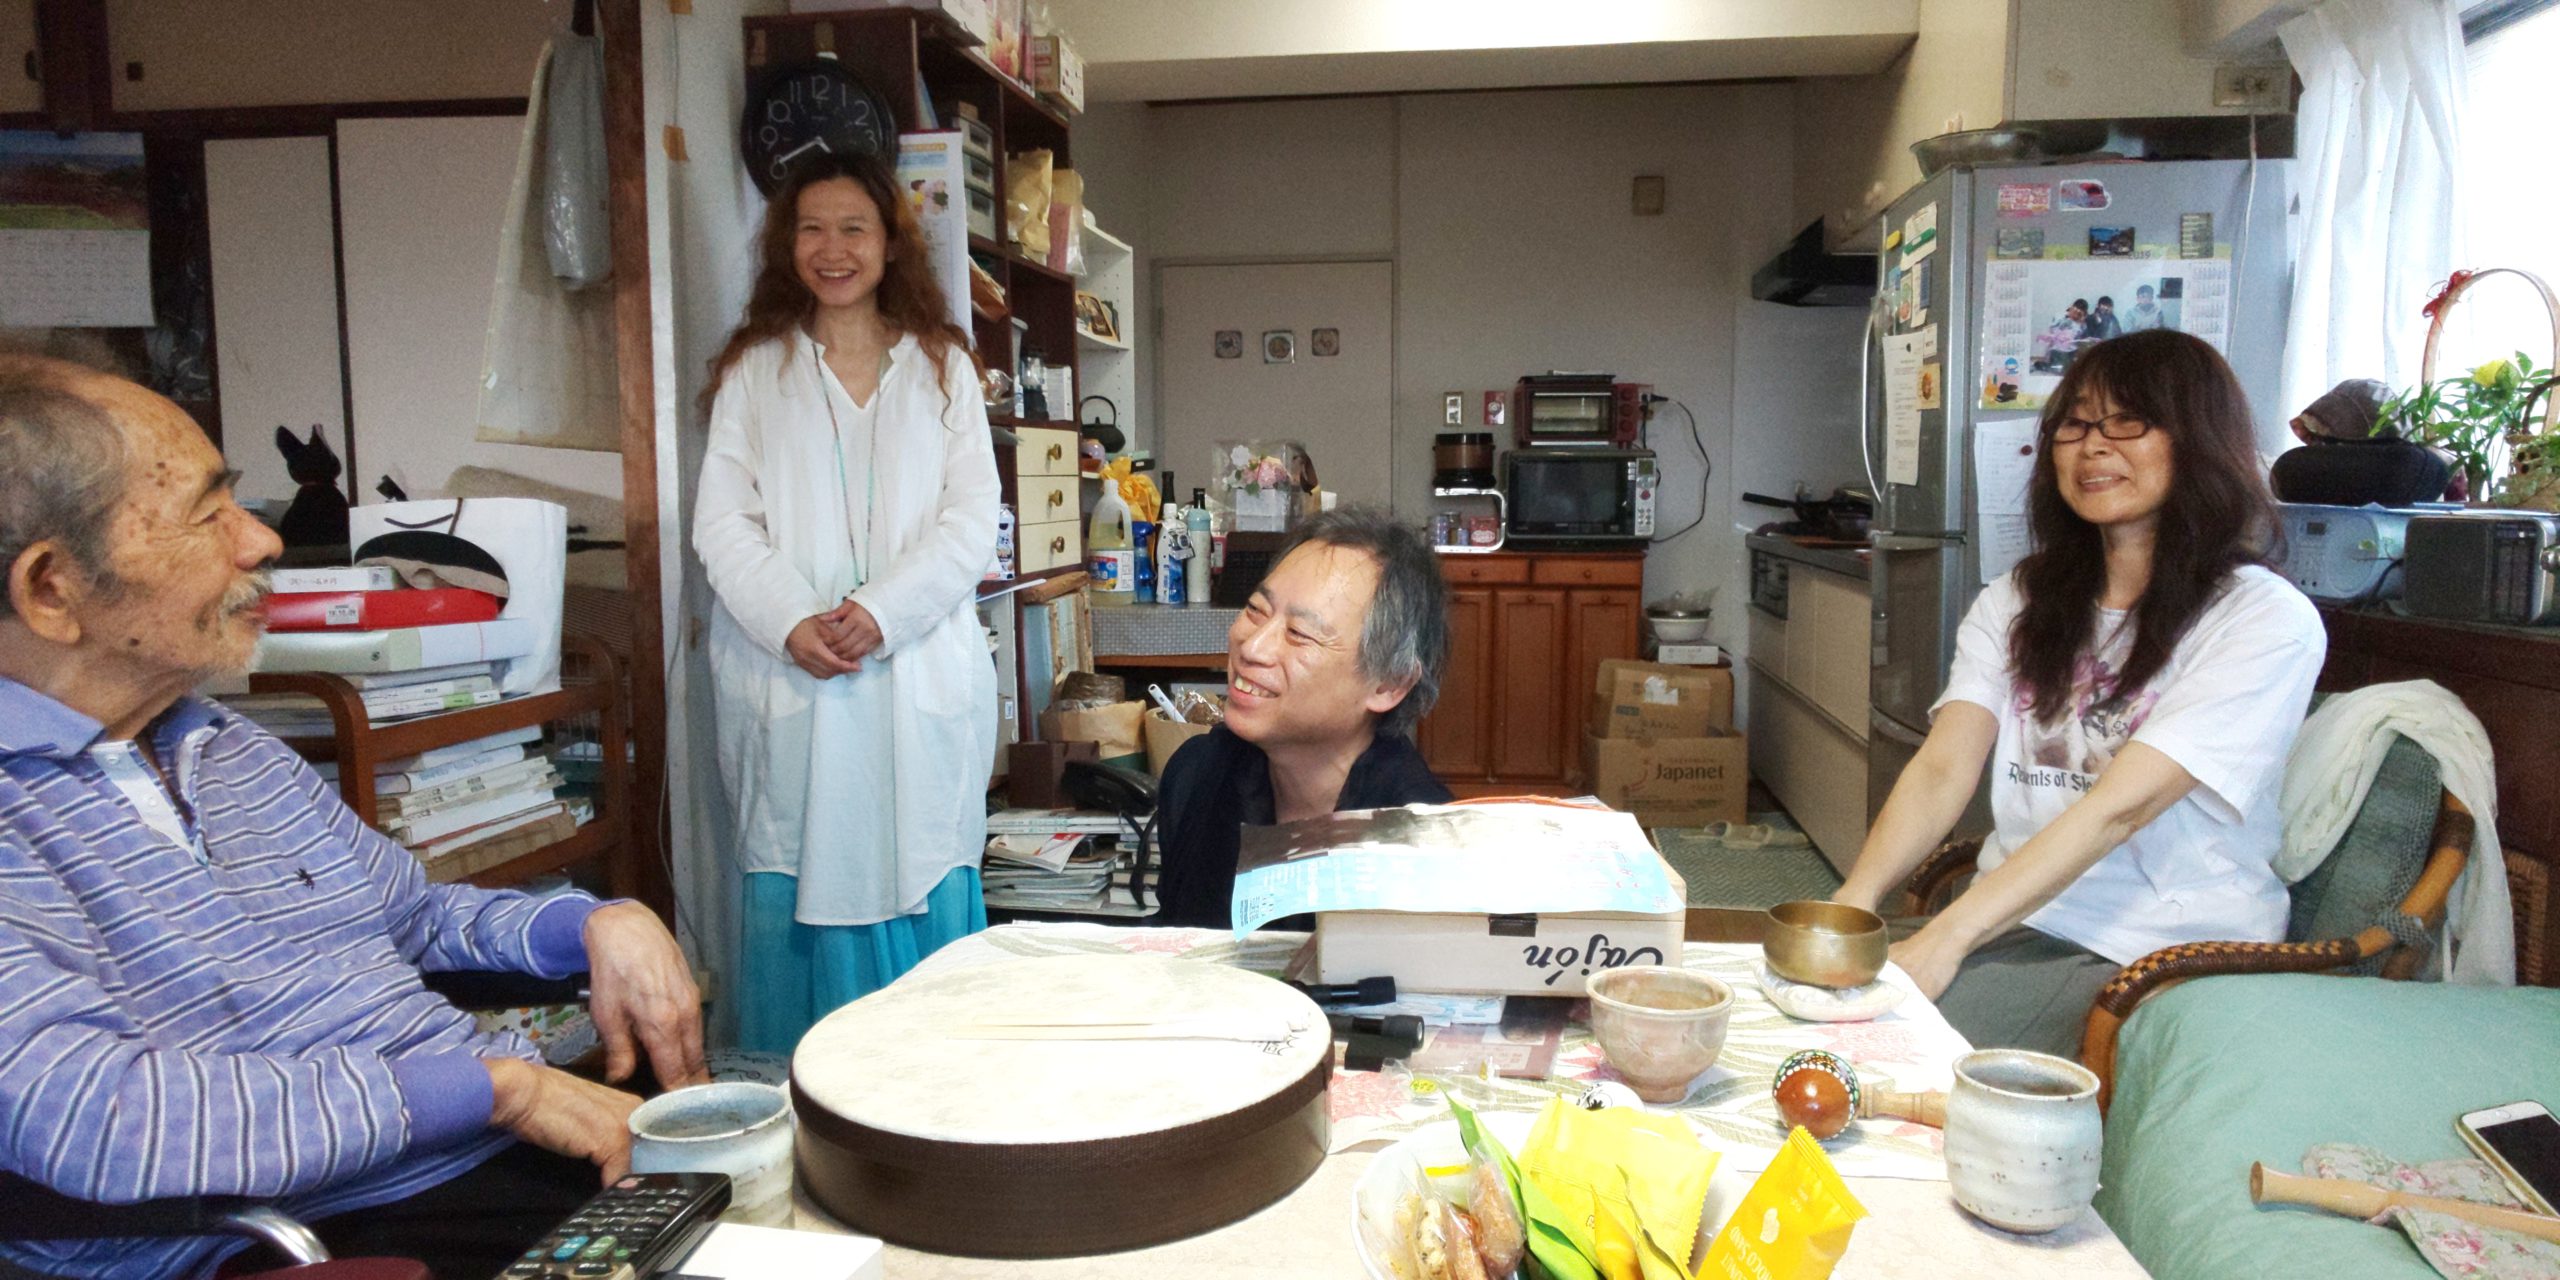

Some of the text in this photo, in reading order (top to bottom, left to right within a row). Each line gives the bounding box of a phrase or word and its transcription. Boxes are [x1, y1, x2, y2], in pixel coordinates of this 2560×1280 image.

[789, 80, 801, 104] 11
[811, 74, 830, 101] 12
[766, 98, 791, 123] 10
[854, 99, 870, 127] 2
[759, 125, 778, 153] 9
[865, 129, 879, 155] 3
[1655, 763, 1725, 783] Japanet
